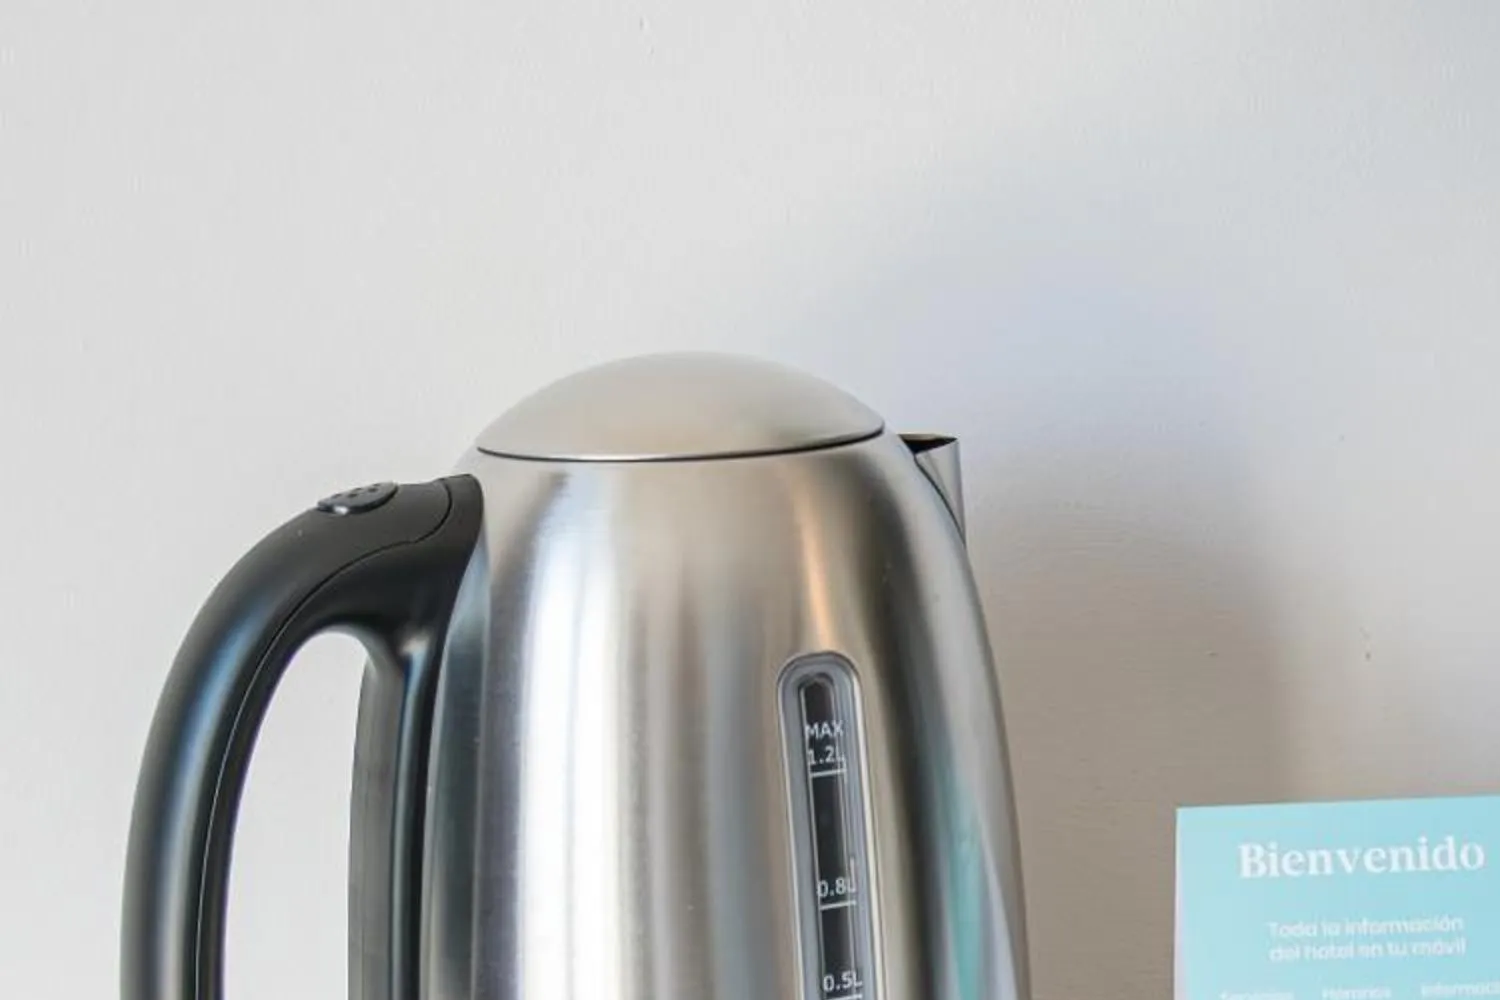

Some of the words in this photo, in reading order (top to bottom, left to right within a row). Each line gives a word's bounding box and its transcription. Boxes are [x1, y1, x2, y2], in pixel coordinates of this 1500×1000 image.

[805, 721, 843, 739] MAX
[1238, 836, 1485, 879] Bienvenido
[1267, 920, 1318, 938] Toda
[1322, 919, 1341, 937] la
[1269, 944, 1300, 962] del
[1305, 942, 1355, 960] hotel
[1358, 945, 1383, 959] en
